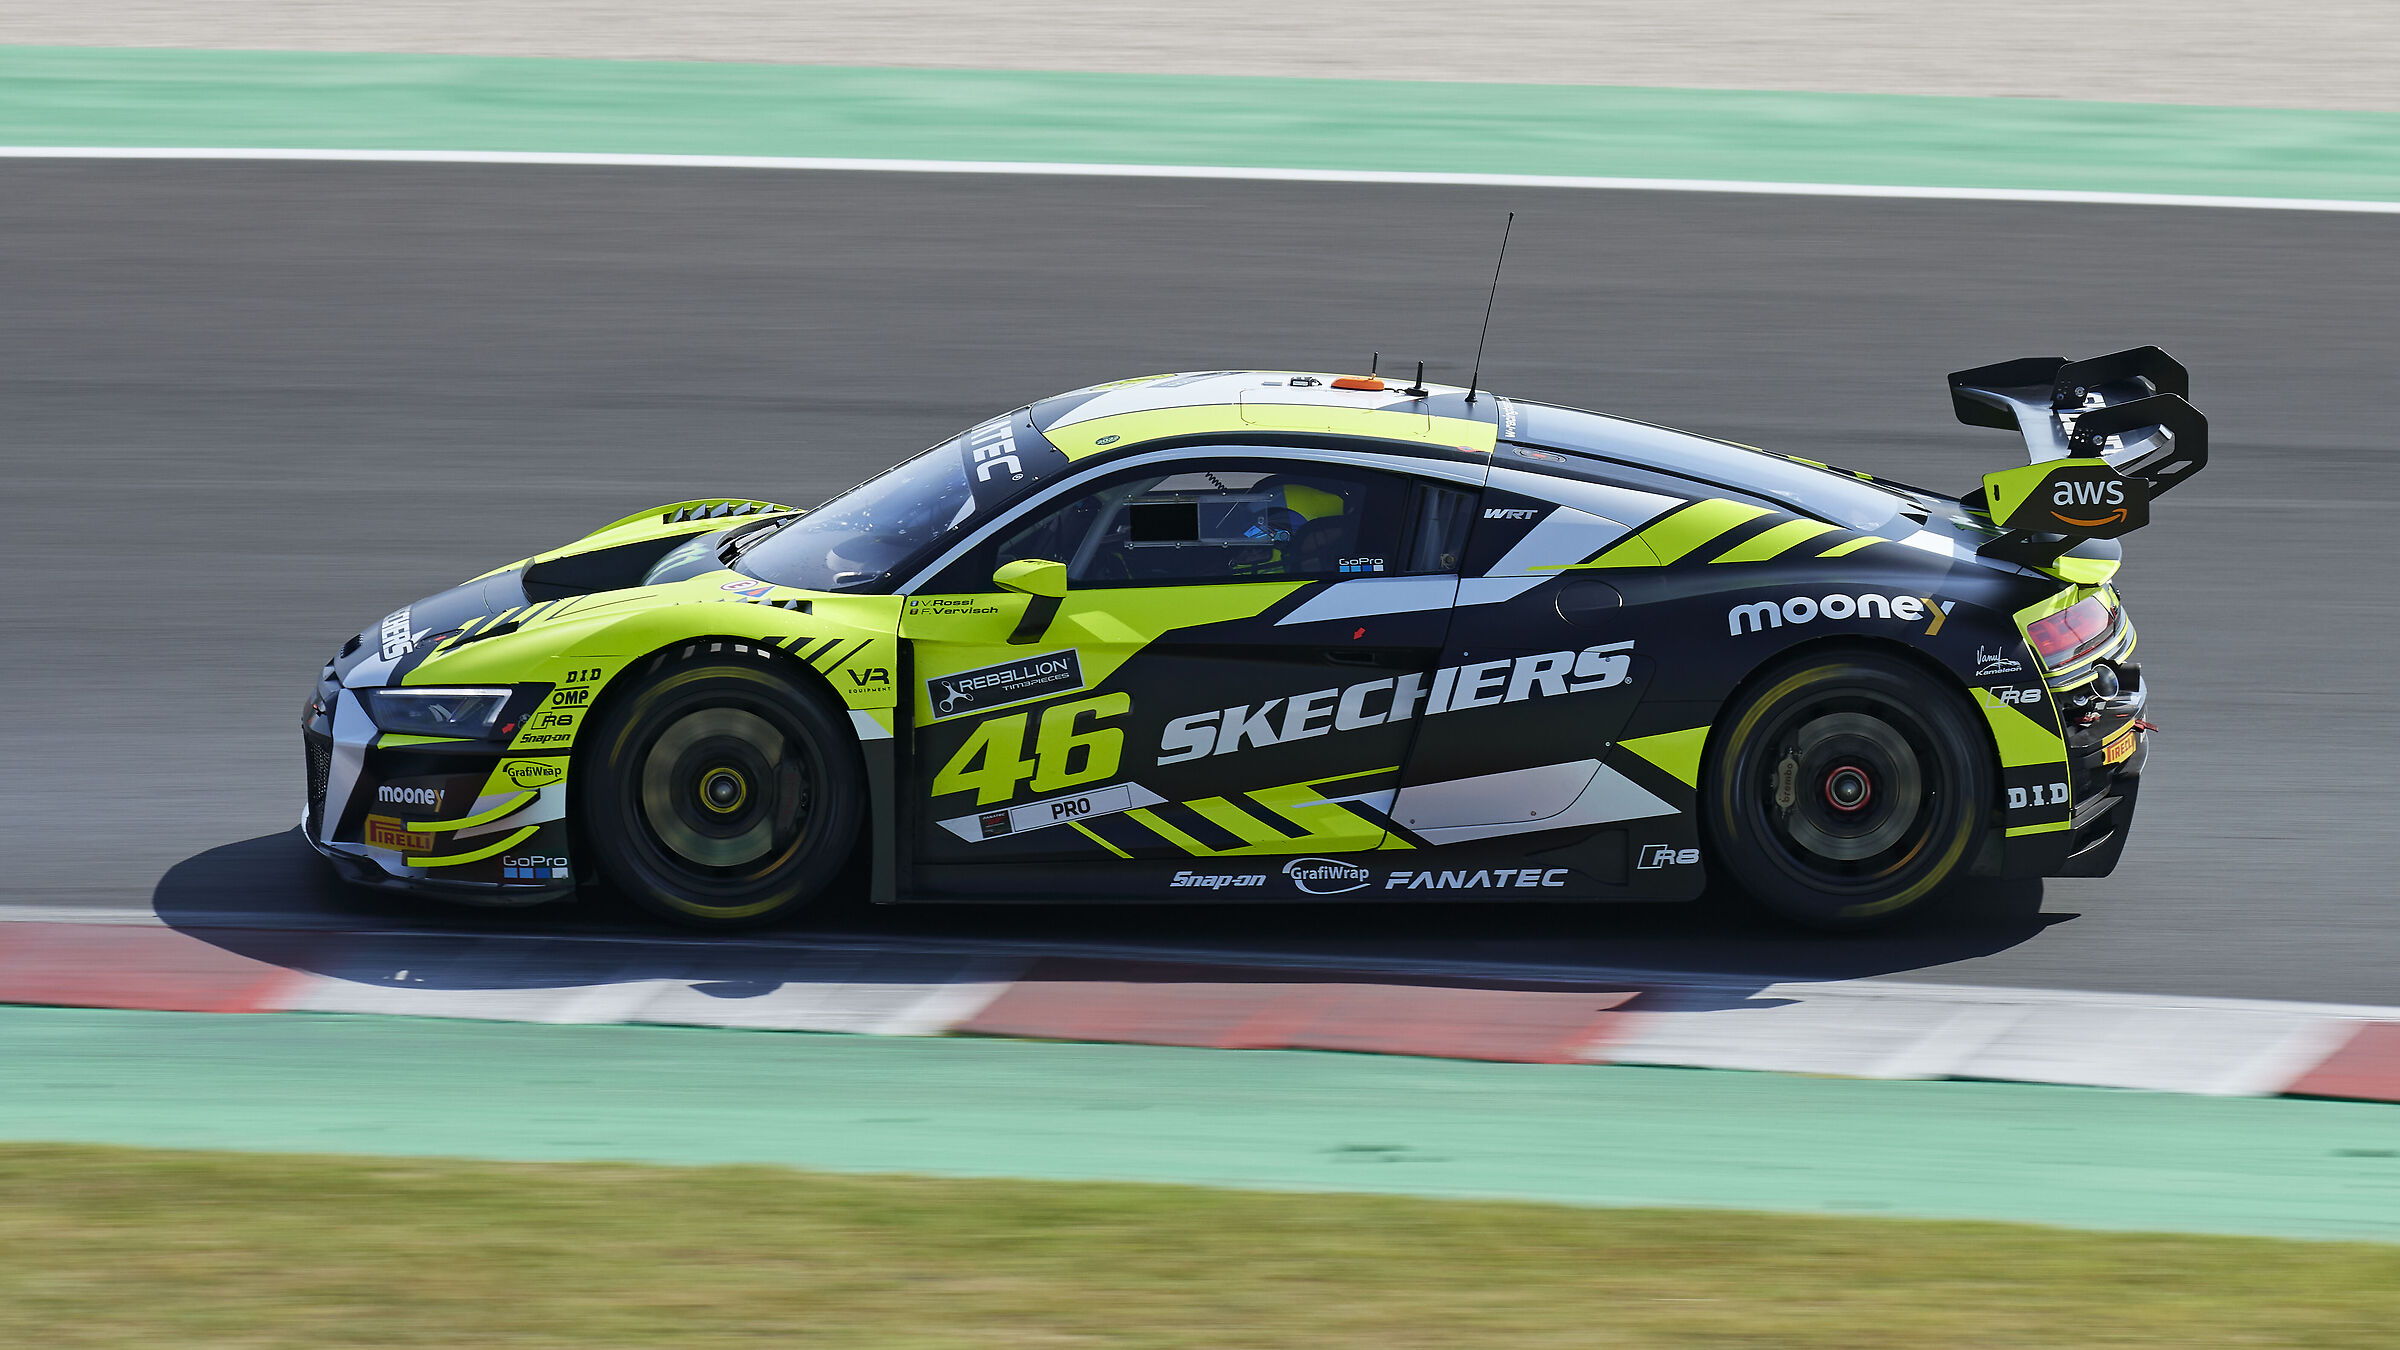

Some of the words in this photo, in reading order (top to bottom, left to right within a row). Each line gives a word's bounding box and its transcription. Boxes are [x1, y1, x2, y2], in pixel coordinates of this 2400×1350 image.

[2053, 477, 2124, 506] aws
[1484, 508, 1539, 519] WRT
[1338, 557, 1384, 566] GoPro
[1728, 593, 1956, 637] mooney
[566, 668, 602, 684] D.I.D
[846, 667, 890, 687] VR
[552, 689, 589, 706] OMP
[848, 686, 892, 694] EQUIPMENT
[2000, 688, 2042, 704] R8
[1156, 639, 1636, 767] SKECHERS
[541, 713, 574, 728] R8
[520, 733, 571, 745] Snap-on
[930, 691, 1131, 807] 46
[508, 766, 562, 778] GrafiWrap
[378, 785, 445, 812] mooney
[2007, 782, 2069, 810] D.I.D
[1051, 797, 1092, 821] PRO
[369, 819, 433, 850] PIRELLI
[503, 855, 568, 867] GoPro
[1651, 847, 1700, 866] R8
[1169, 870, 1267, 891] Snap-on
[1290, 864, 1371, 884] GrafiWrap
[1384, 868, 1569, 890] FANATEC
